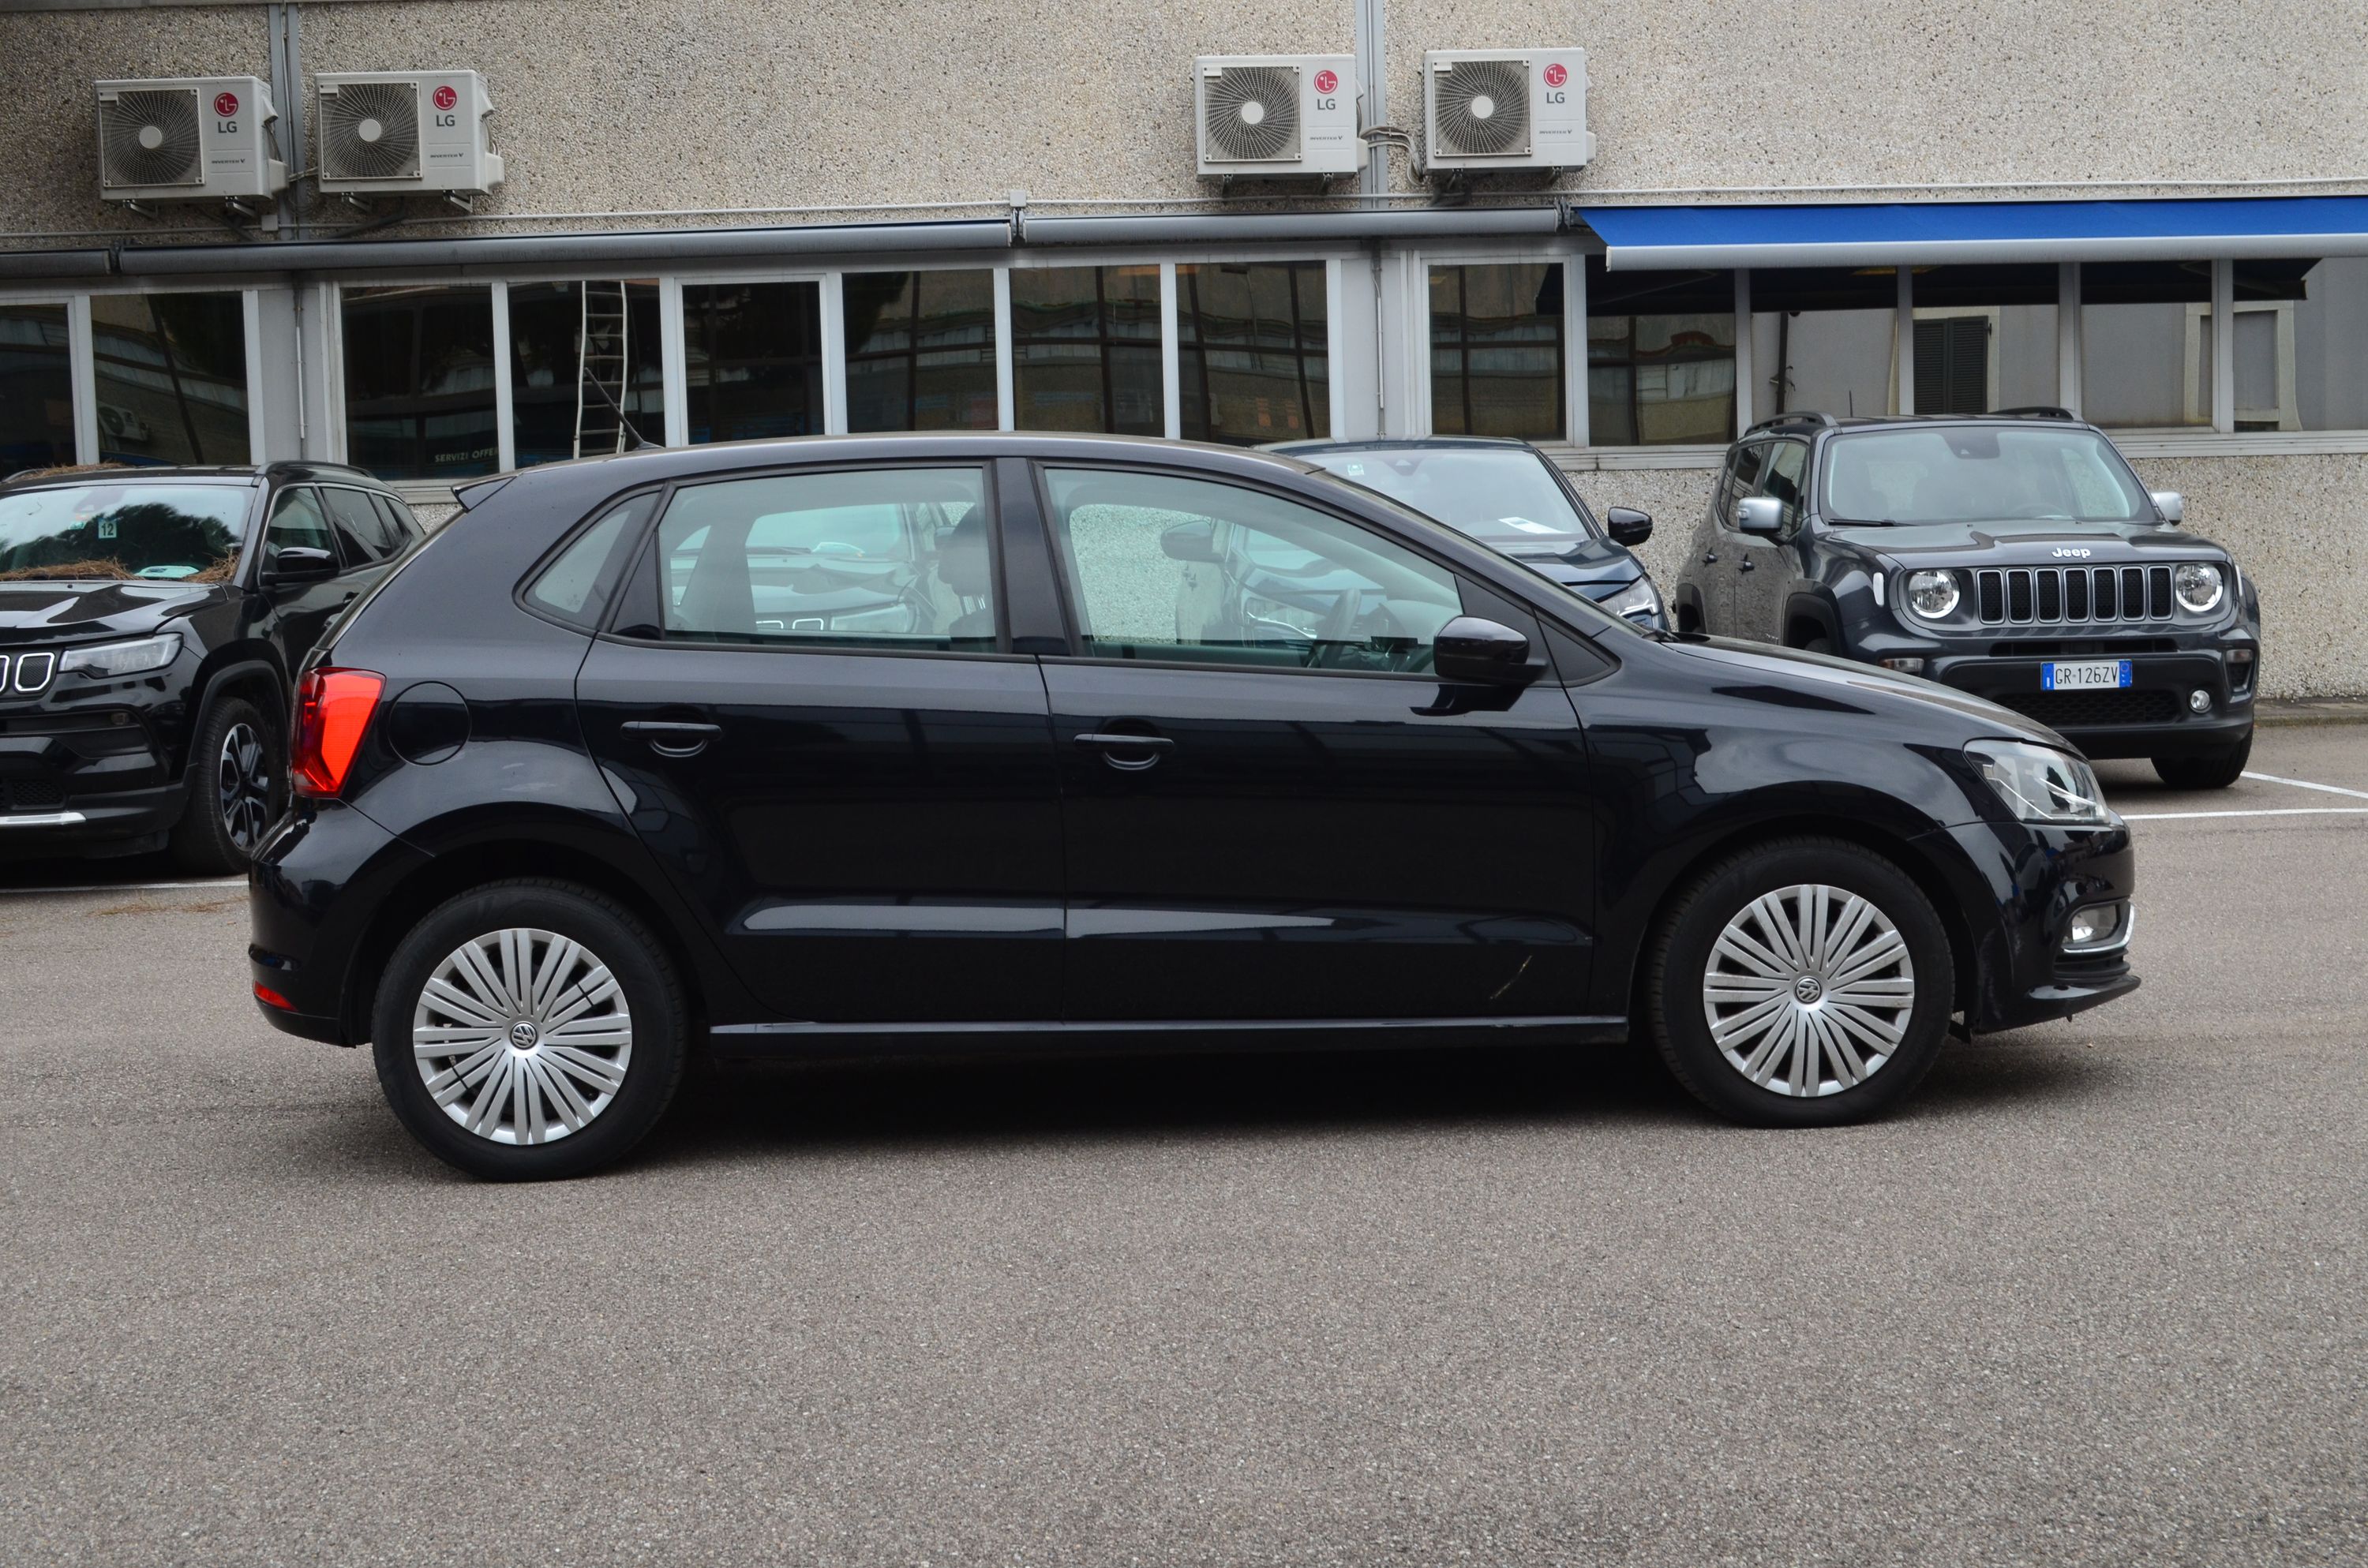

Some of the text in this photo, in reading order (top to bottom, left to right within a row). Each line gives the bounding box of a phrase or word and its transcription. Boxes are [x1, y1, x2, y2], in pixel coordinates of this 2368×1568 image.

[1546, 92, 1565, 103] LG
[1317, 99, 1336, 110] LG
[436, 114, 455, 126] LG
[218, 121, 238, 133] LG
[435, 451, 468, 462] SERVIZI
[101, 523, 114, 536] 12
[2052, 547, 2091, 559] Jeep
